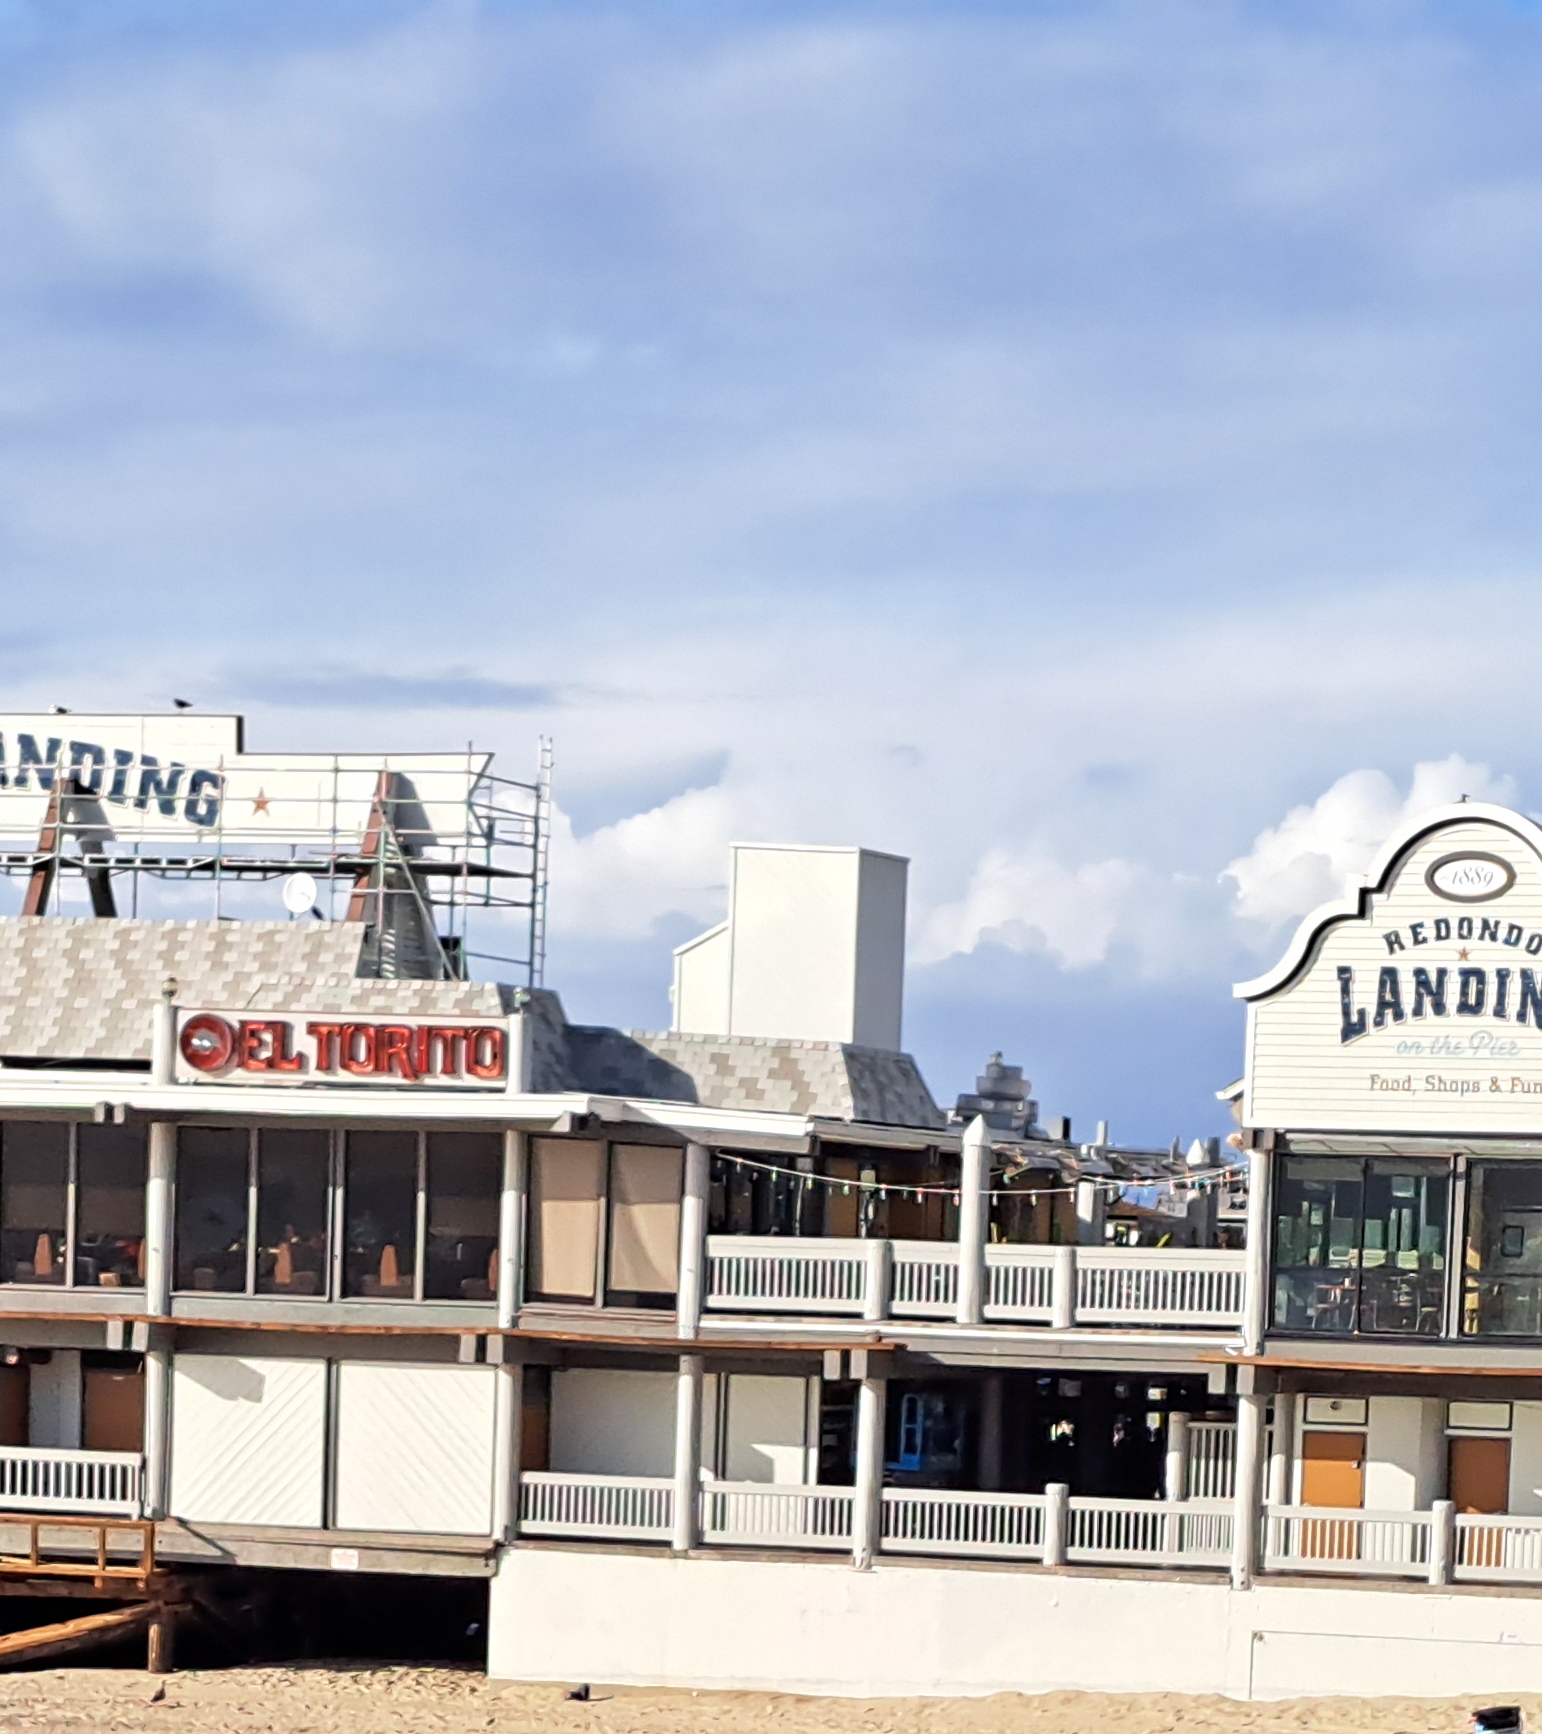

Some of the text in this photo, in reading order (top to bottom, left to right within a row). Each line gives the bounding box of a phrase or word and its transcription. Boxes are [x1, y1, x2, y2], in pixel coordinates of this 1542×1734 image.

[1451, 865, 1495, 888] 1889
[239, 1020, 506, 1081] EL TORITO
[1395, 1030, 1523, 1057] on the Pier
[1369, 1073, 1416, 1095] Food,
[1424, 1074, 1481, 1097] Shops
[1488, 1076, 1503, 1093] &
